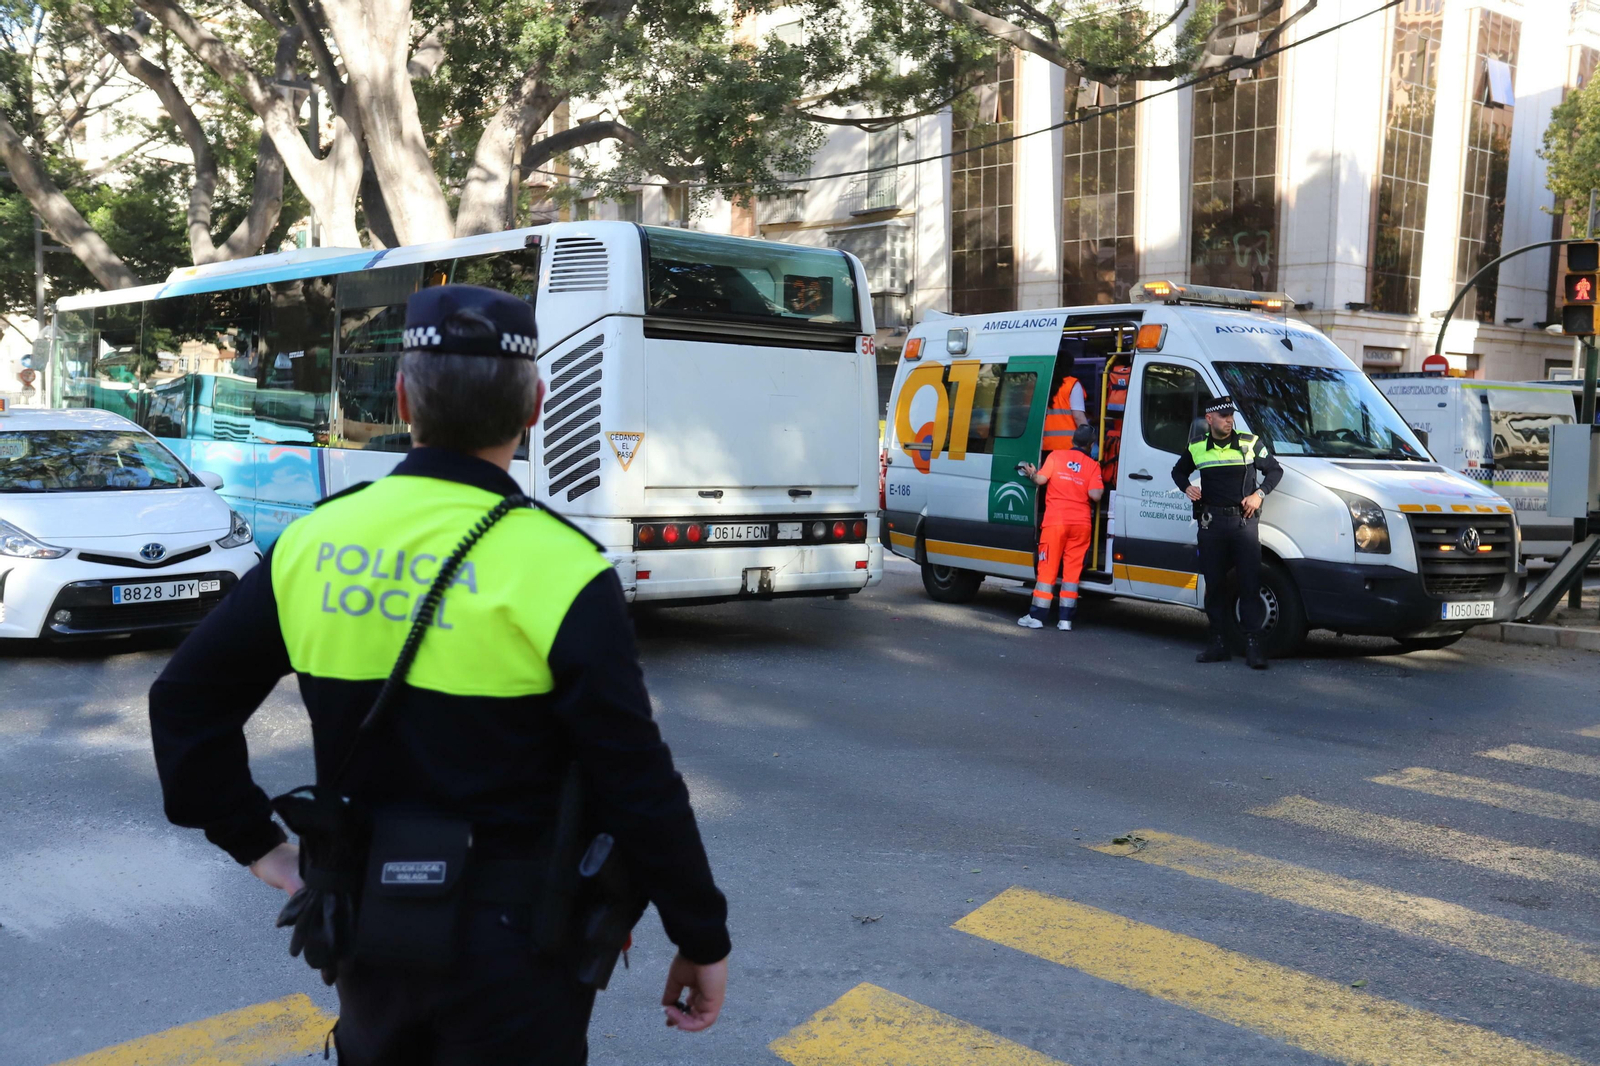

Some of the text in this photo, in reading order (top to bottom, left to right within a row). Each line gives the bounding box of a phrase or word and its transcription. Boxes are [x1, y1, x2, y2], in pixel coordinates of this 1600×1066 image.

[982, 317, 1058, 331] AMBULANCIA
[622, 442, 629, 450] EL
[617, 451, 633, 459] PASO
[889, 483, 911, 496] E-186
[1141, 489, 1164, 499] Empresa
[1141, 500, 1148, 508] de
[1149, 500, 1182, 511] Emergencias
[1168, 513, 1175, 521] DE
[1176, 514, 1192, 522] SALUD
[714, 525, 768, 540] 0614 FCN
[201, 581, 218, 591] SP
[123, 583, 195, 601] 8828 JPY
[1450, 603, 1491, 617] 1050 GZR
